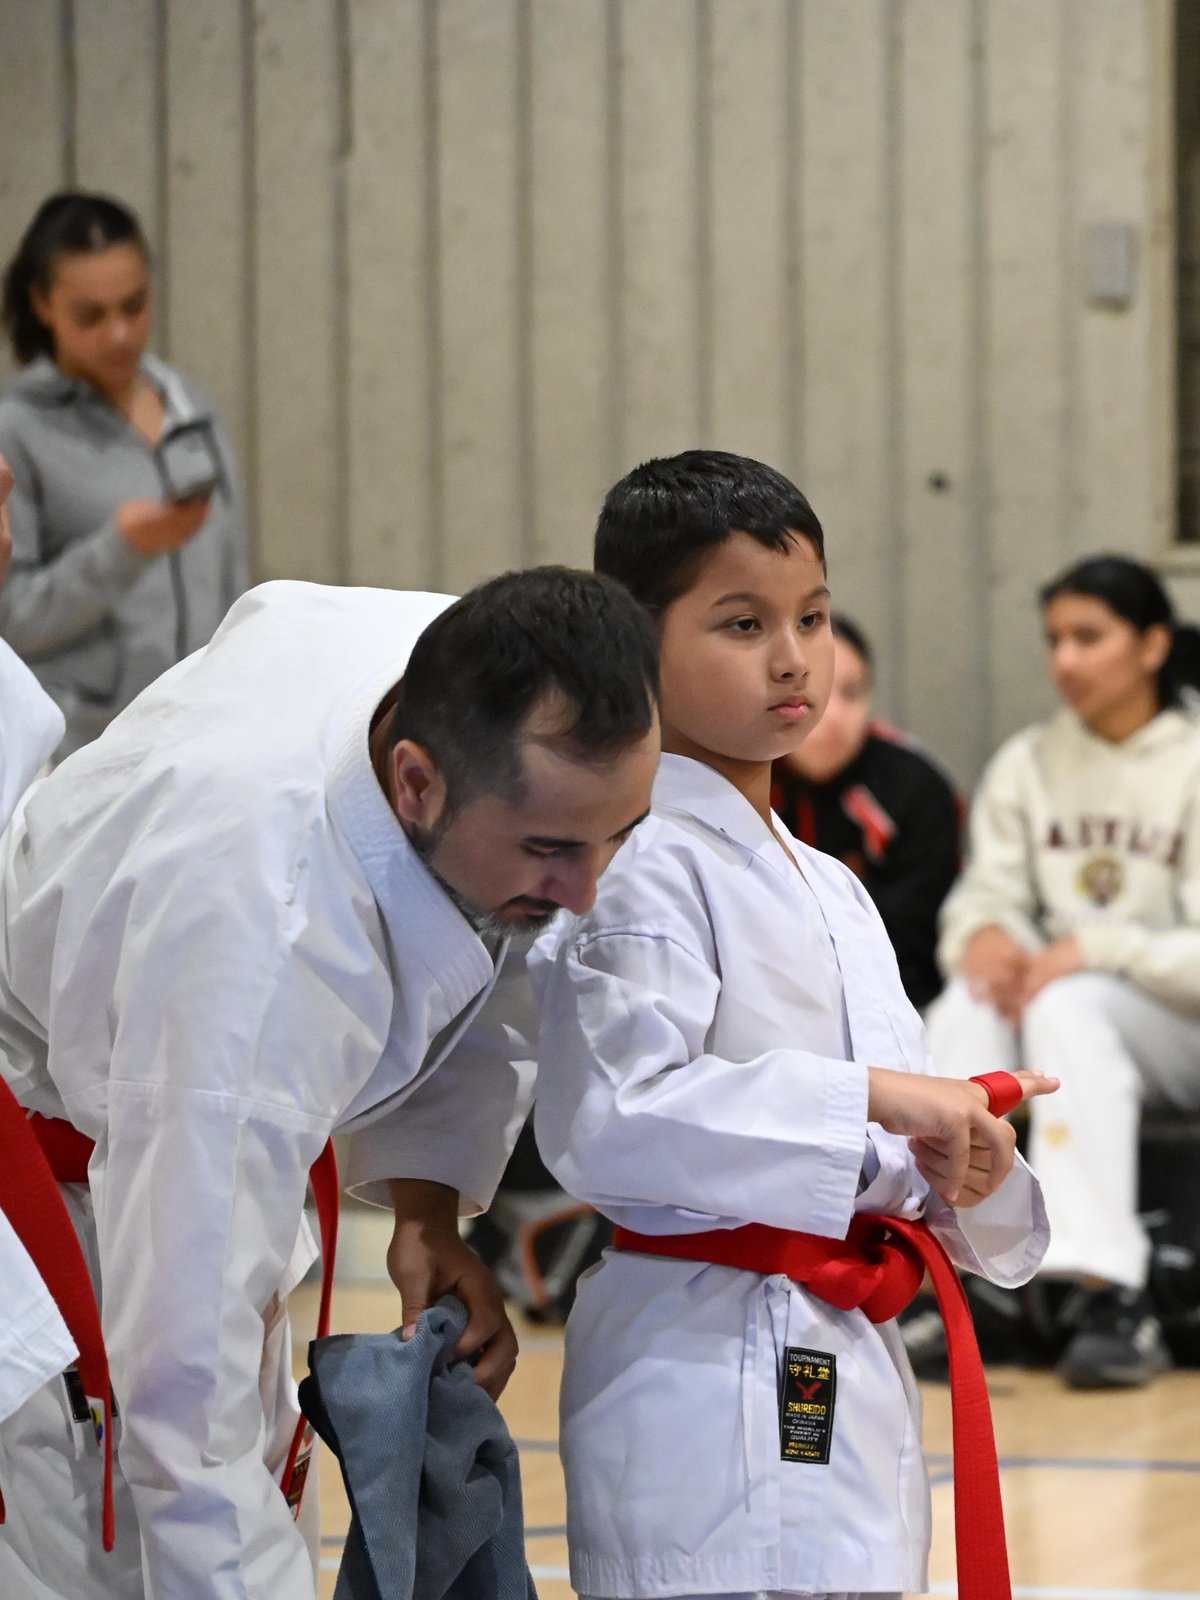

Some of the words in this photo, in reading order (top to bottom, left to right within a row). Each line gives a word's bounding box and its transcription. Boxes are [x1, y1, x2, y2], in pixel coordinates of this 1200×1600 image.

[790, 1353, 831, 1366] TOURNAMENT
[788, 1402, 827, 1415] SHUREIDO
[791, 1434, 819, 1442] QUALITY
